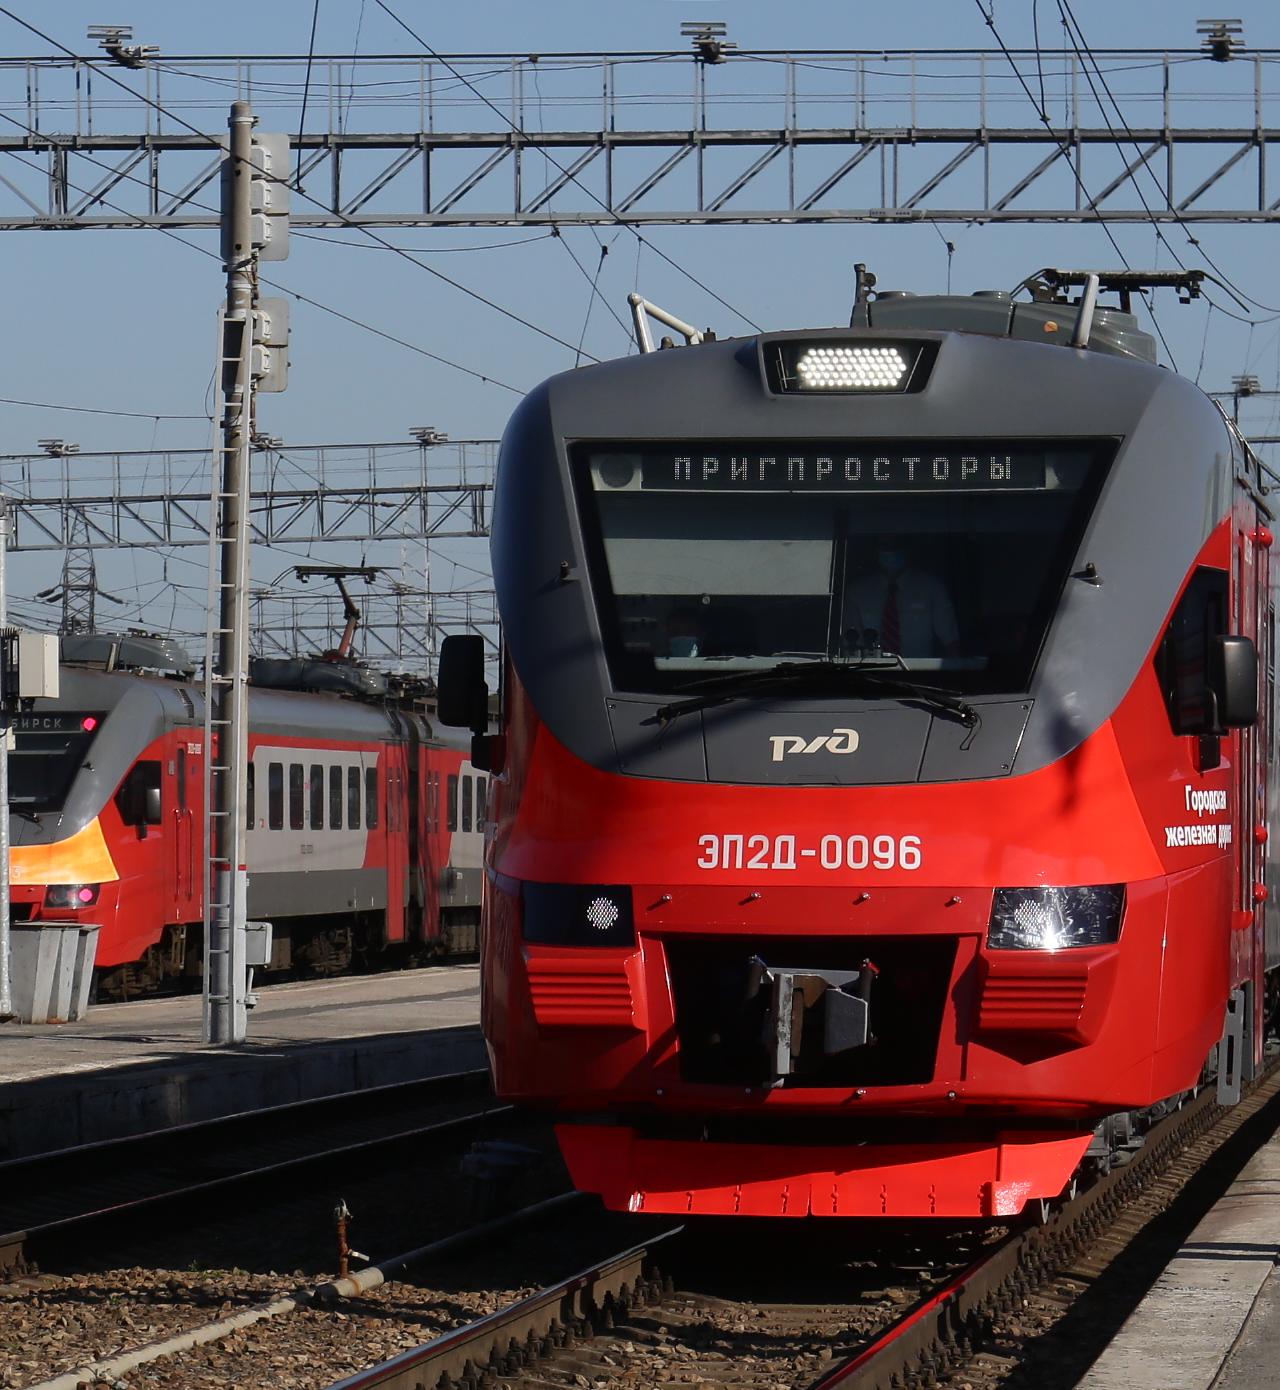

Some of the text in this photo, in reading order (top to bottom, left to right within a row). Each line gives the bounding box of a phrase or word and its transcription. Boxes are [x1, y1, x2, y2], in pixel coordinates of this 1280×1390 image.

[673, 456, 1012, 481] ПРИГПРОСТОРЫ
[1185, 785, 1227, 818] Городская
[1164, 824, 1216, 848] железная
[697, 834, 922, 870] ЭП2Д-0096
